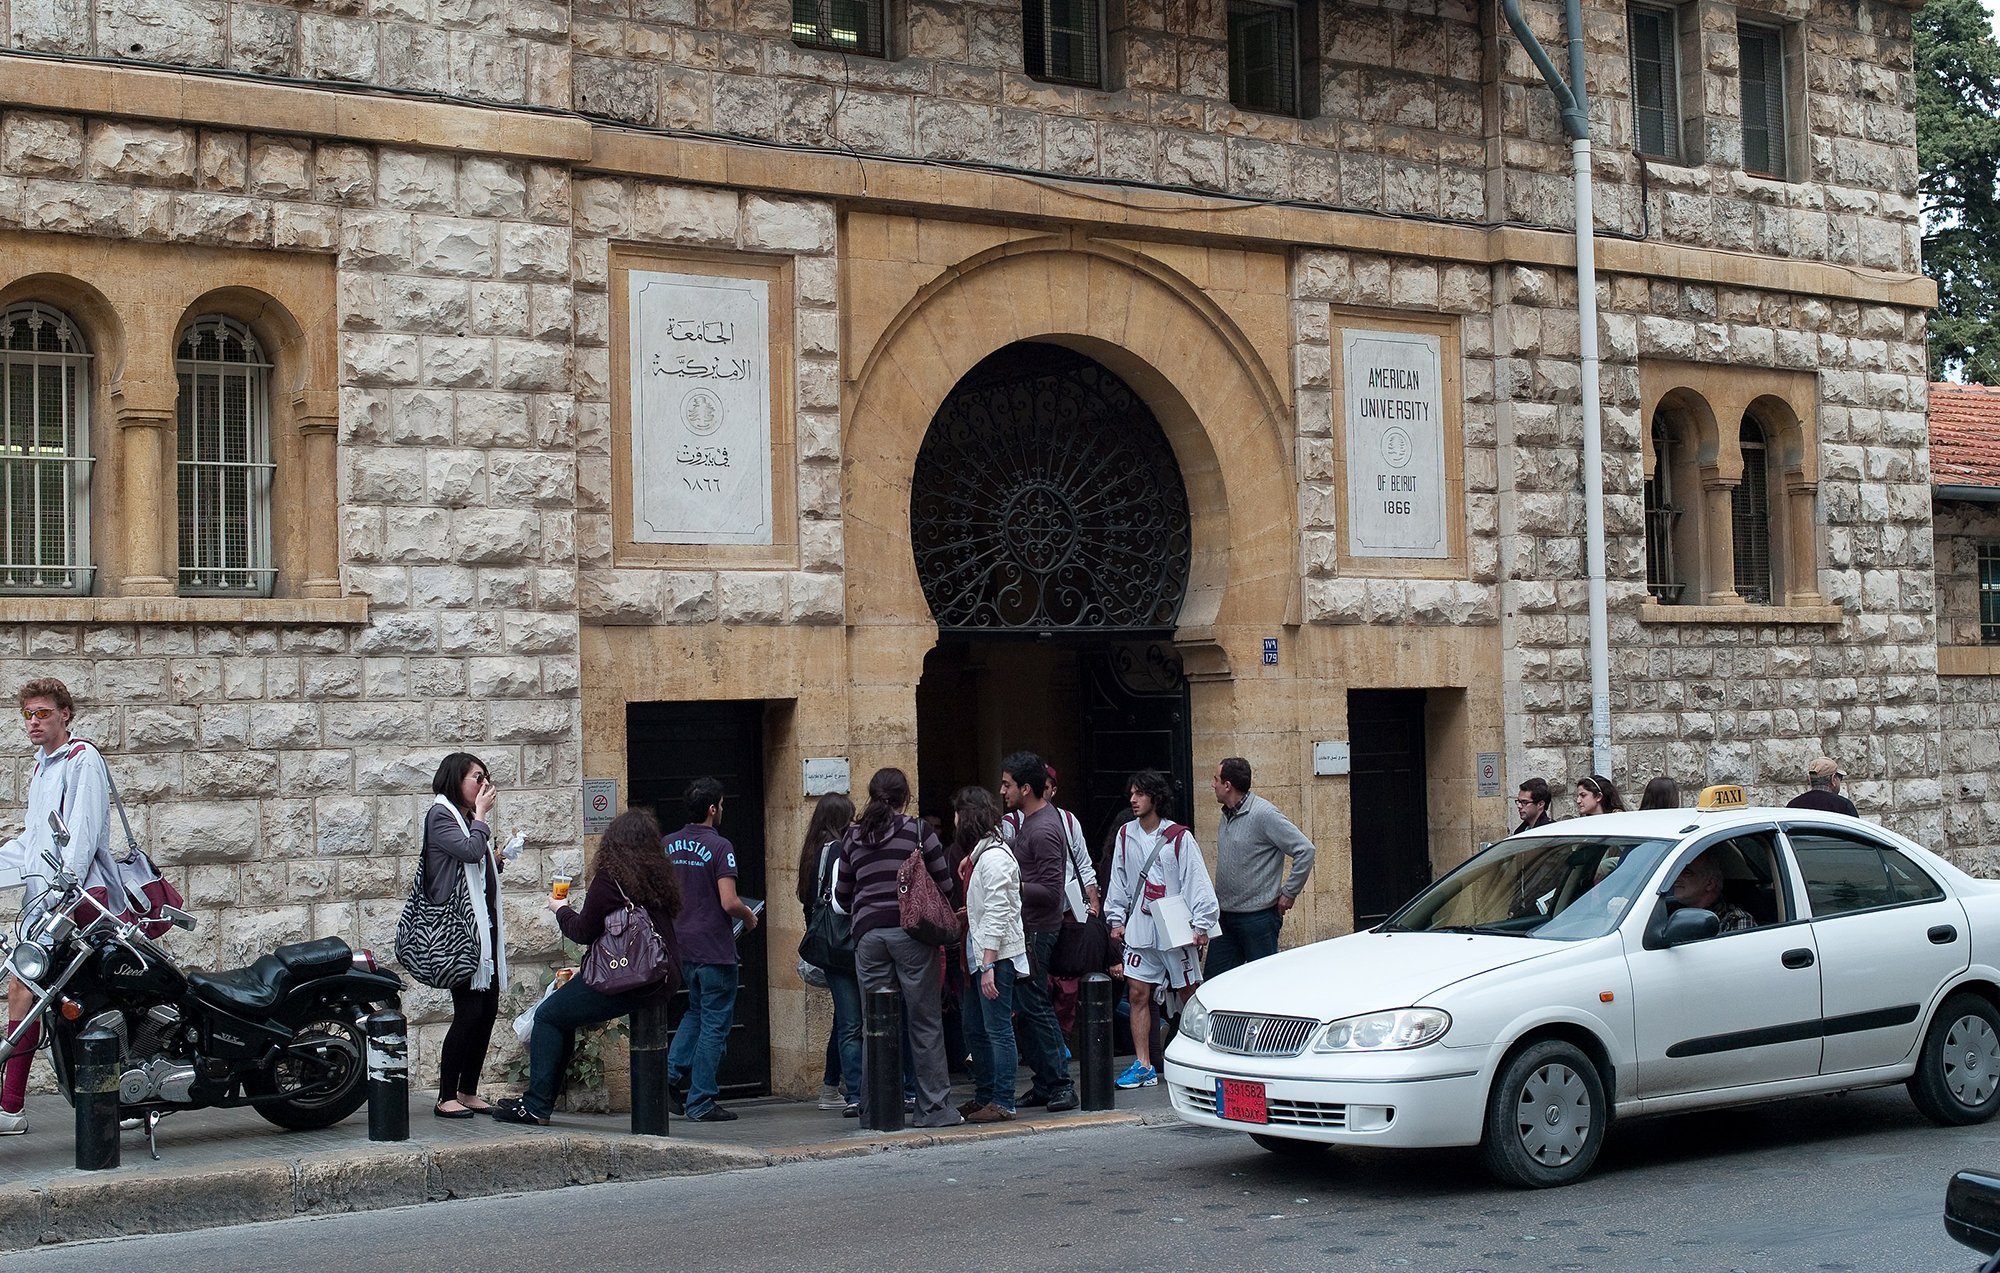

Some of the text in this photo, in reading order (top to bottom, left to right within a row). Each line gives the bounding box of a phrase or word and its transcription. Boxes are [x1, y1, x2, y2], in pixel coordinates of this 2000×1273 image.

[1368, 368, 1419, 390] AMERICAN
[1360, 398, 1429, 421] UNIVERSITY
[1377, 474, 1416, 492] OF BEIRUT
[1383, 500, 1411, 514] 1866
[1265, 653, 1277, 663] 179
[1715, 790, 1742, 804] TAXI
[726, 852, 736, 868] 8
[1127, 952, 1142, 968] 10
[1229, 1083, 1263, 1098] 391582
